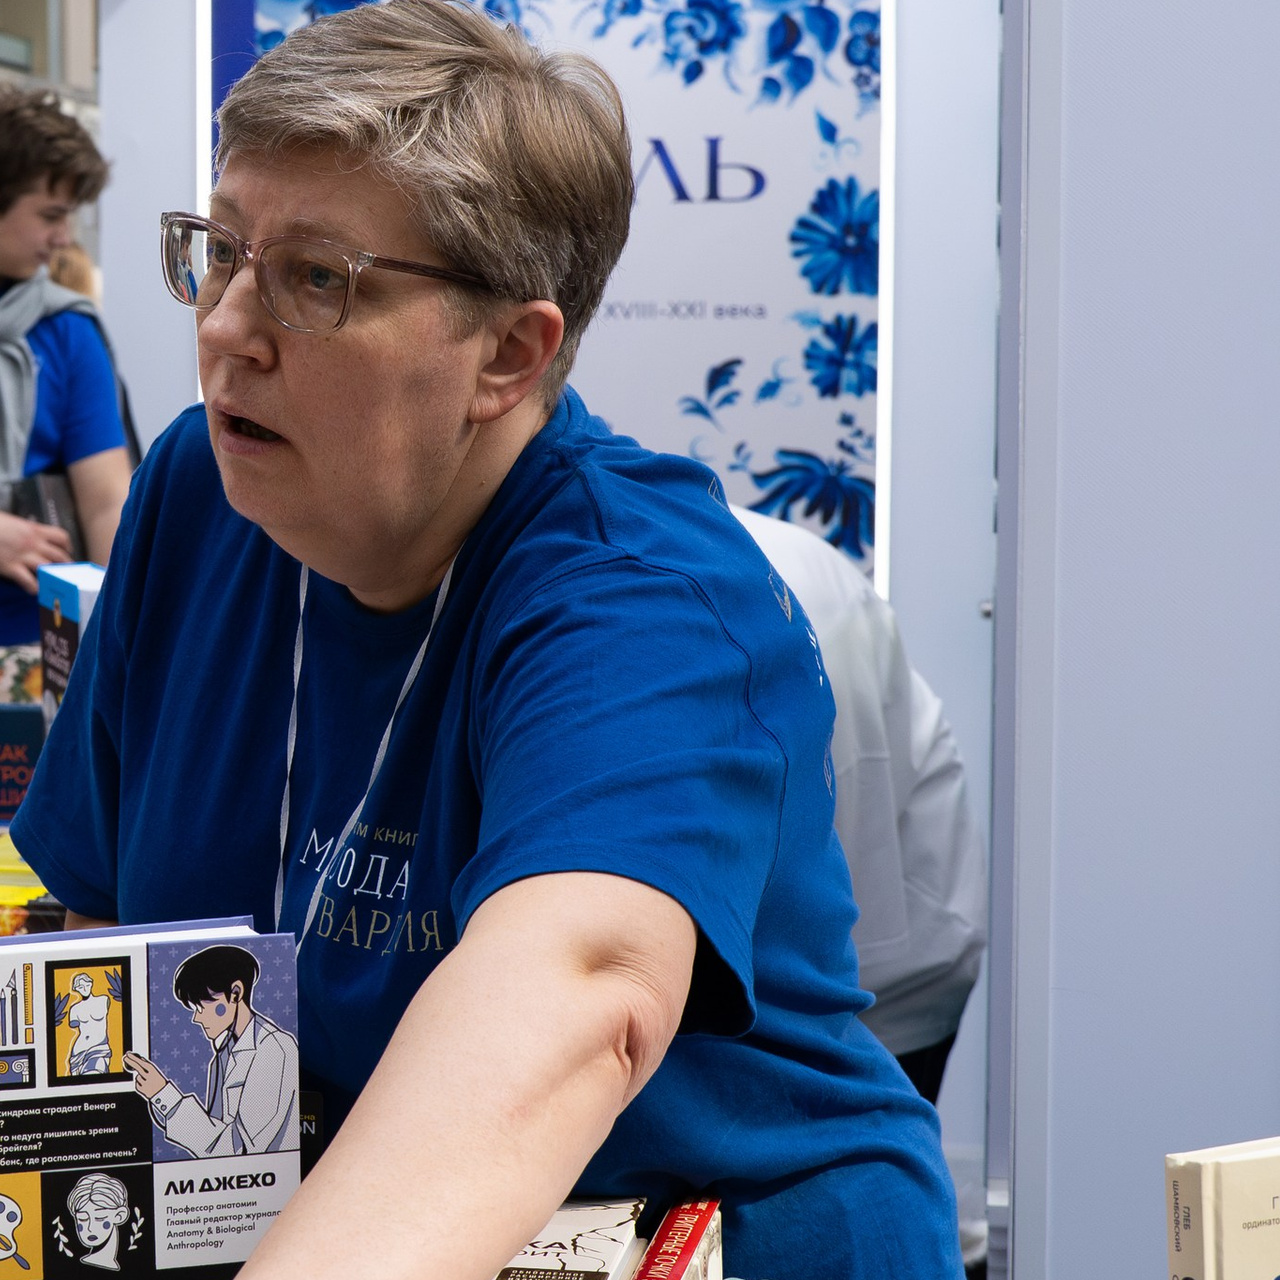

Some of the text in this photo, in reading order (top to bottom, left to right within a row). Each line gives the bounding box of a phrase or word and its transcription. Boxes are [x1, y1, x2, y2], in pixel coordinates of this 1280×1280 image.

[713, 303, 768, 319] века
[42, 1104, 82, 1116] страдает
[83, 1102, 116, 1112] Венера
[11, 1131, 42, 1142] недуга
[43, 1129, 87, 1139] лишились
[88, 1126, 119, 1137] зрения
[25, 1156, 40, 1166] где
[41, 1152, 101, 1164] расположена
[102, 1147, 138, 1159] печень?
[164, 1172, 276, 1196] ЛИ ДЖЕХО
[166, 1200, 257, 1216] Профессор анатомии
[166, 1217, 201, 1227] Главный
[203, 1214, 243, 1225] редактор
[1183, 1205, 1191, 1231] ГЛЕБ
[166, 1222, 256, 1239] Anatomy Biological
[166, 1238, 225, 1251] Anthropology
[511, 1269, 585, 1278] ОБНОВЛЕННОЕ
